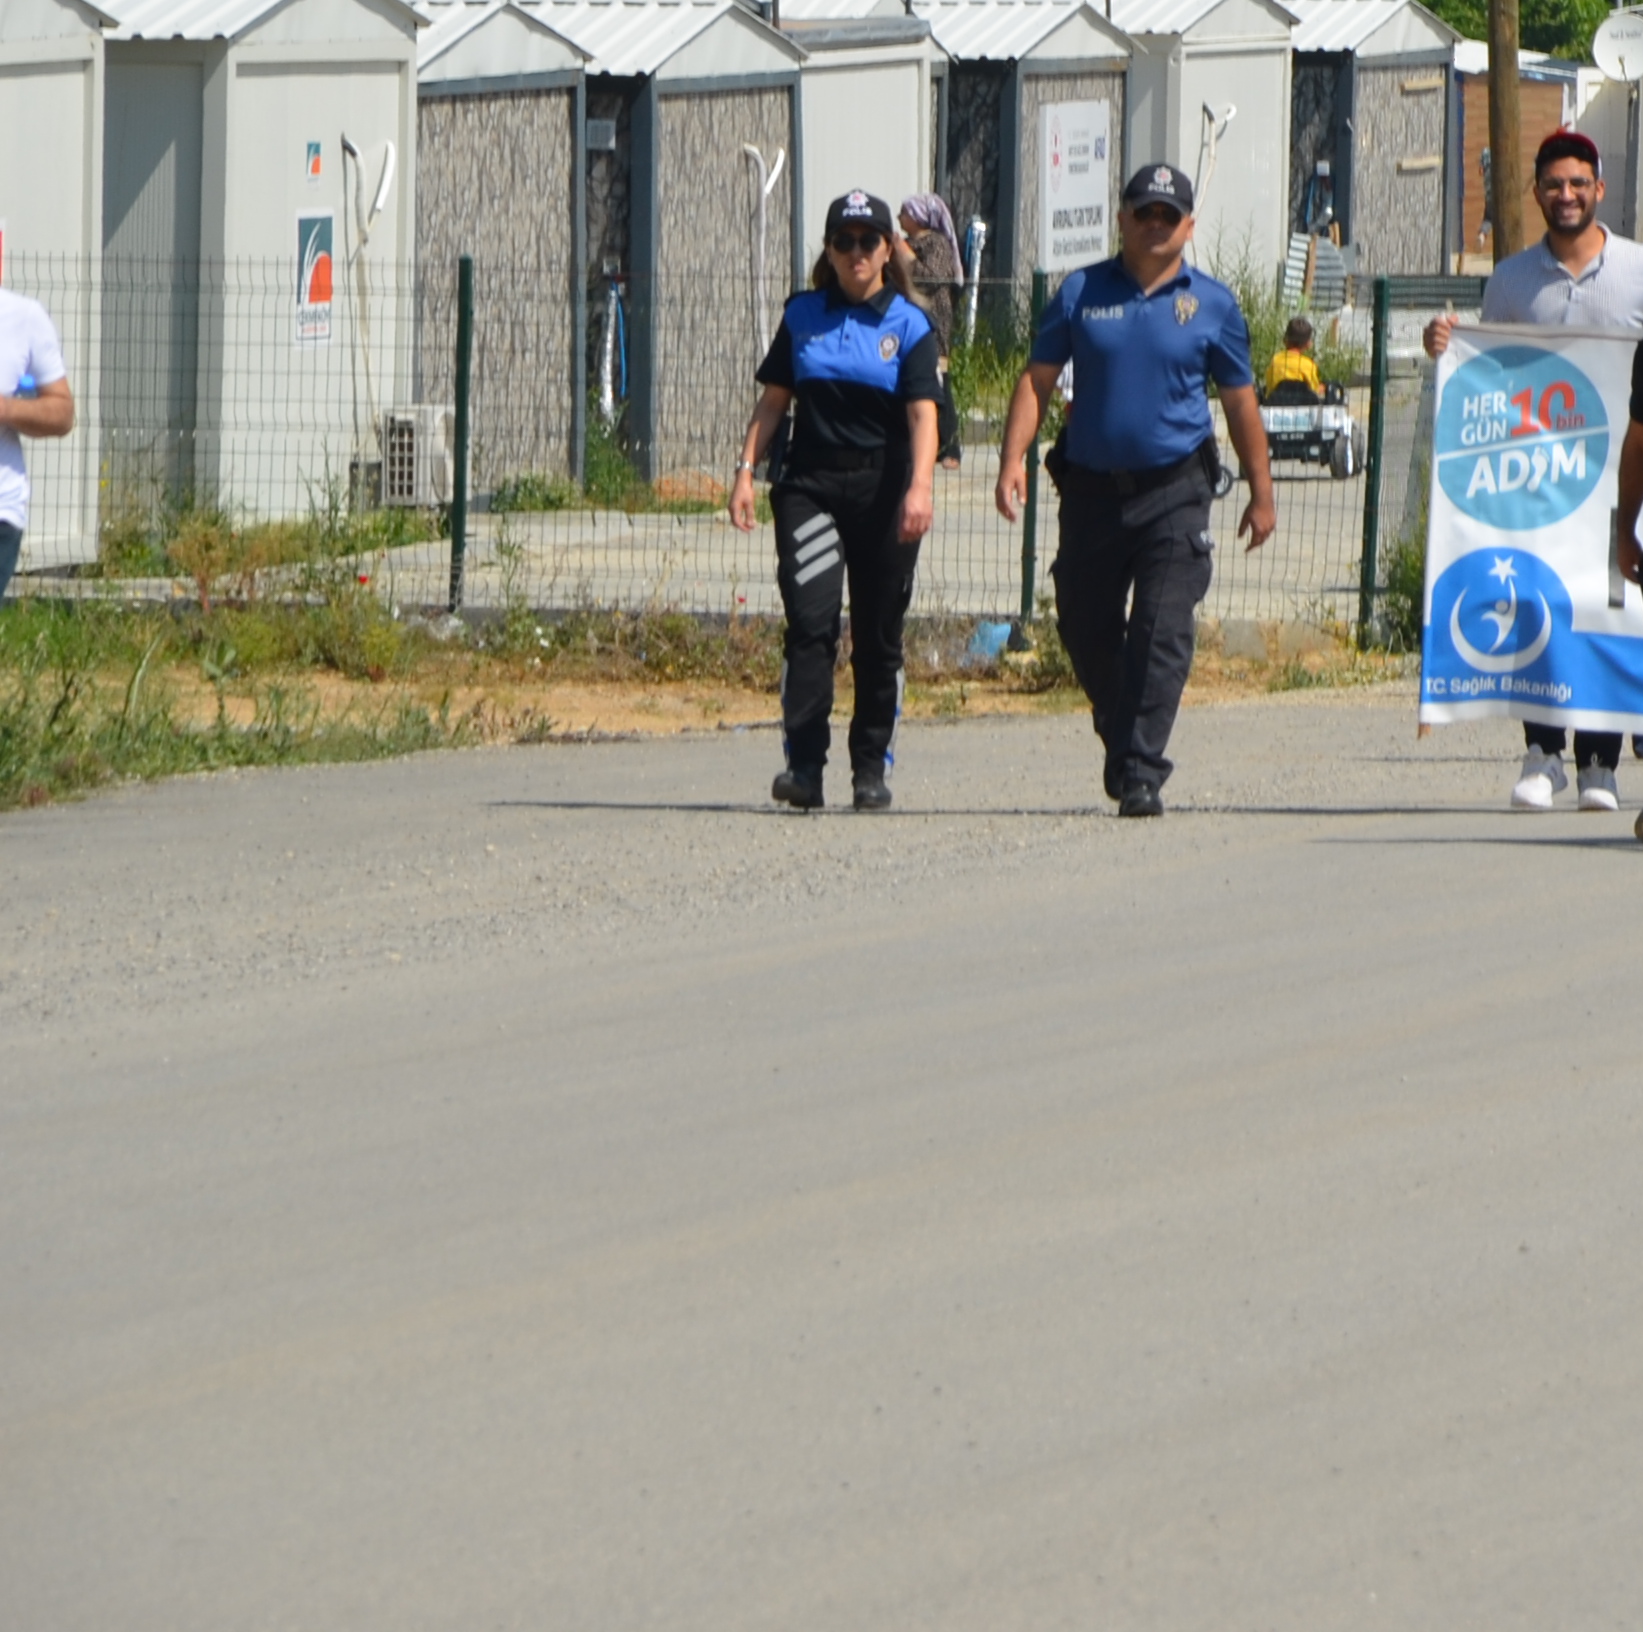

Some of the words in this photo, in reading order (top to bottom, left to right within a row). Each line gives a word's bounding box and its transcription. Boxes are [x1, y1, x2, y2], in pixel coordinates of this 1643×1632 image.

[1463, 389, 1508, 420] HER
[1510, 379, 1576, 439] 10
[1461, 417, 1508, 447] GÜN
[1450, 675, 1498, 696] Sağlık
[1501, 675, 1574, 703] Bakanlığı
